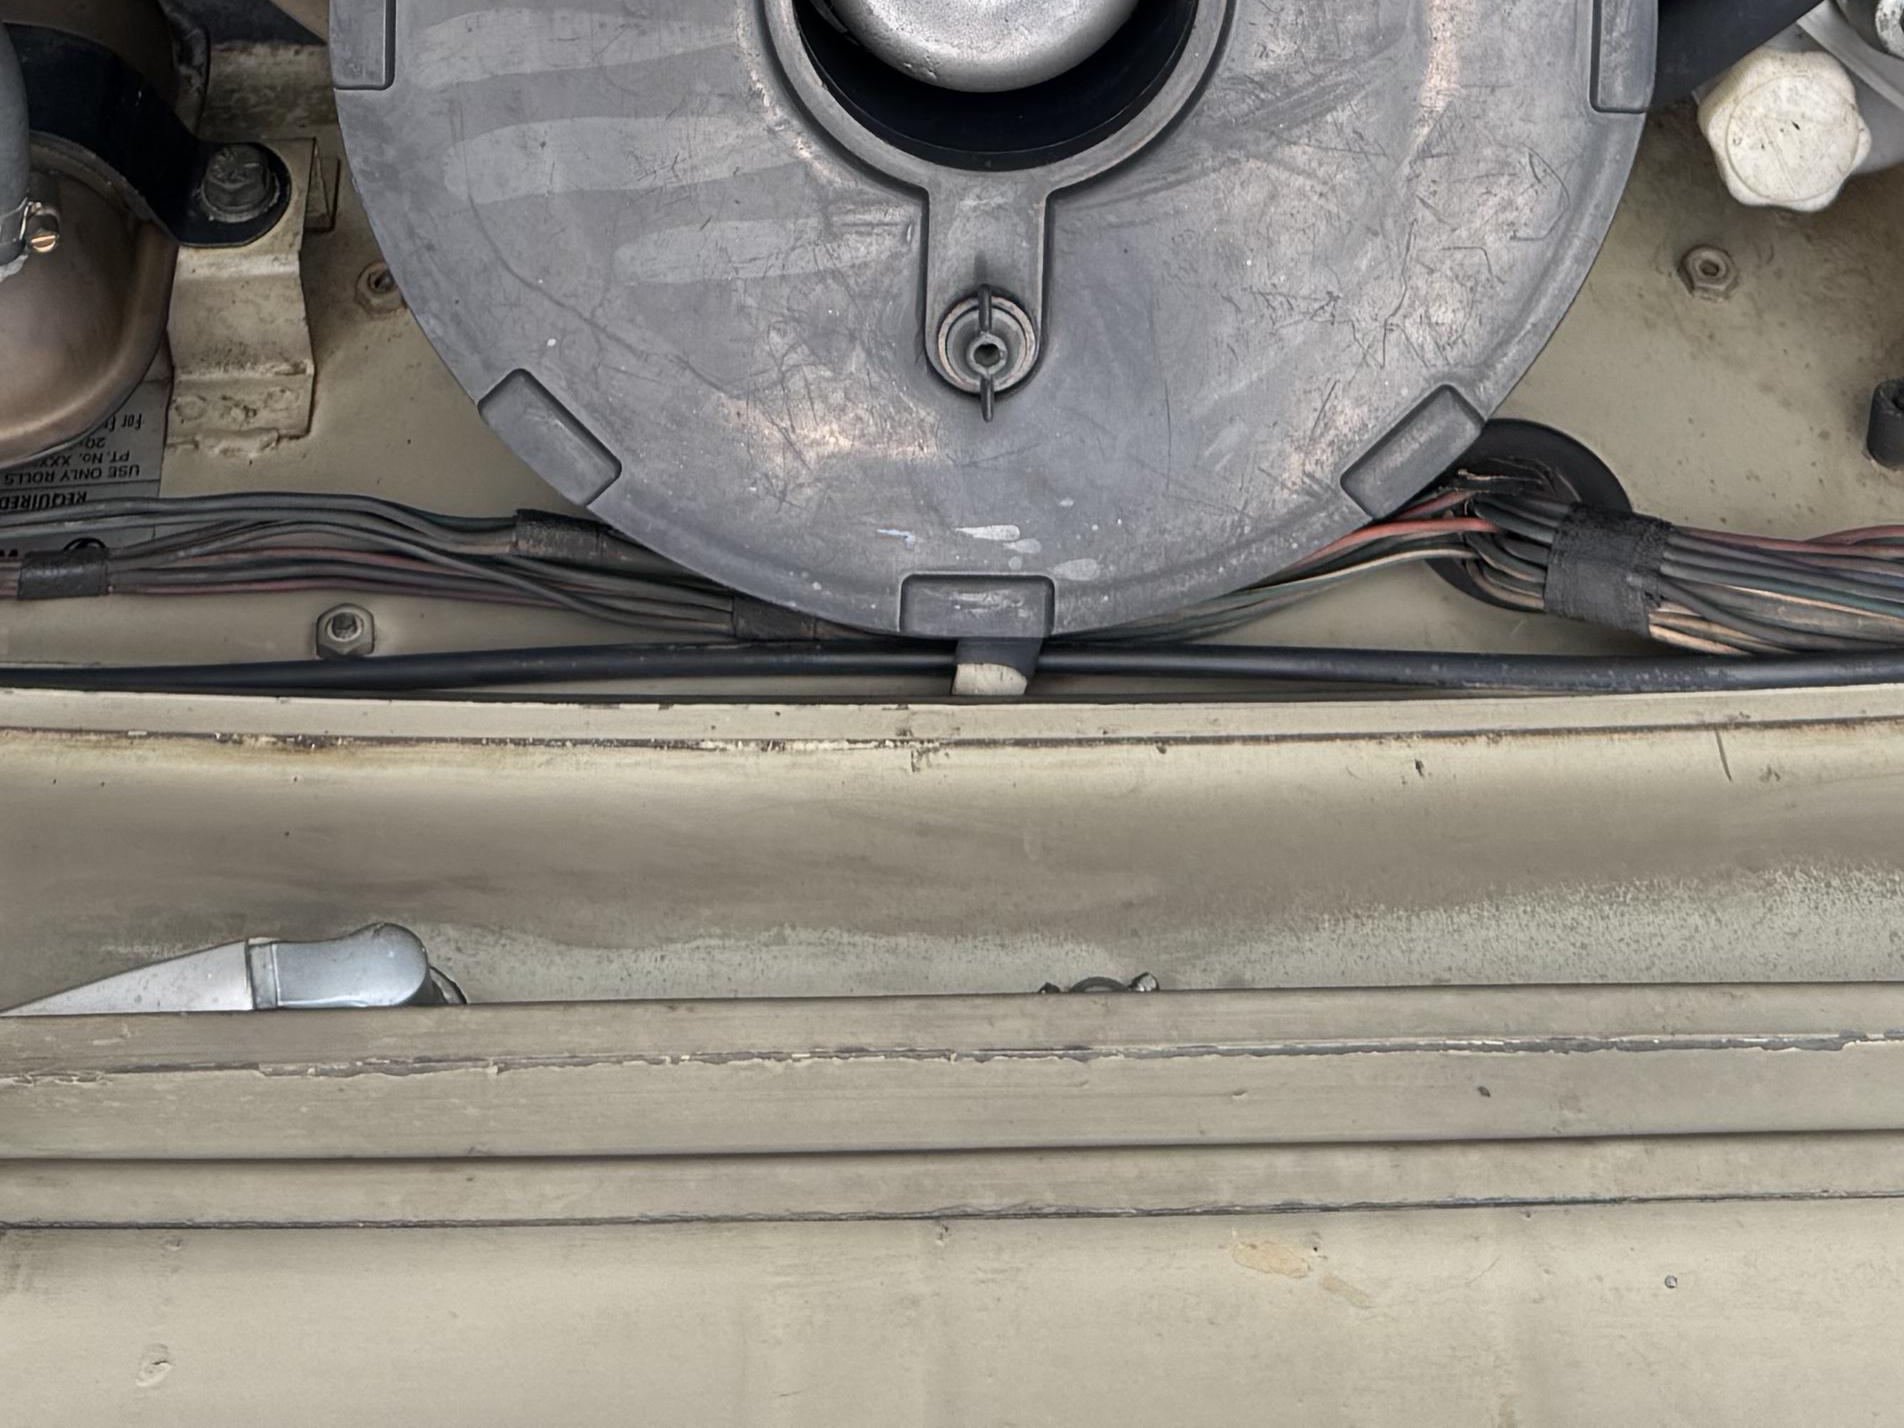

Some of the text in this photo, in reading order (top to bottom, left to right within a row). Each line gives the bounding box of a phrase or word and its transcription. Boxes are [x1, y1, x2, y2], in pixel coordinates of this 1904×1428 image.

[3, 470, 56, 487] ROLLS
[58, 466, 103, 482] ONLY
[107, 463, 141, 479] USE
